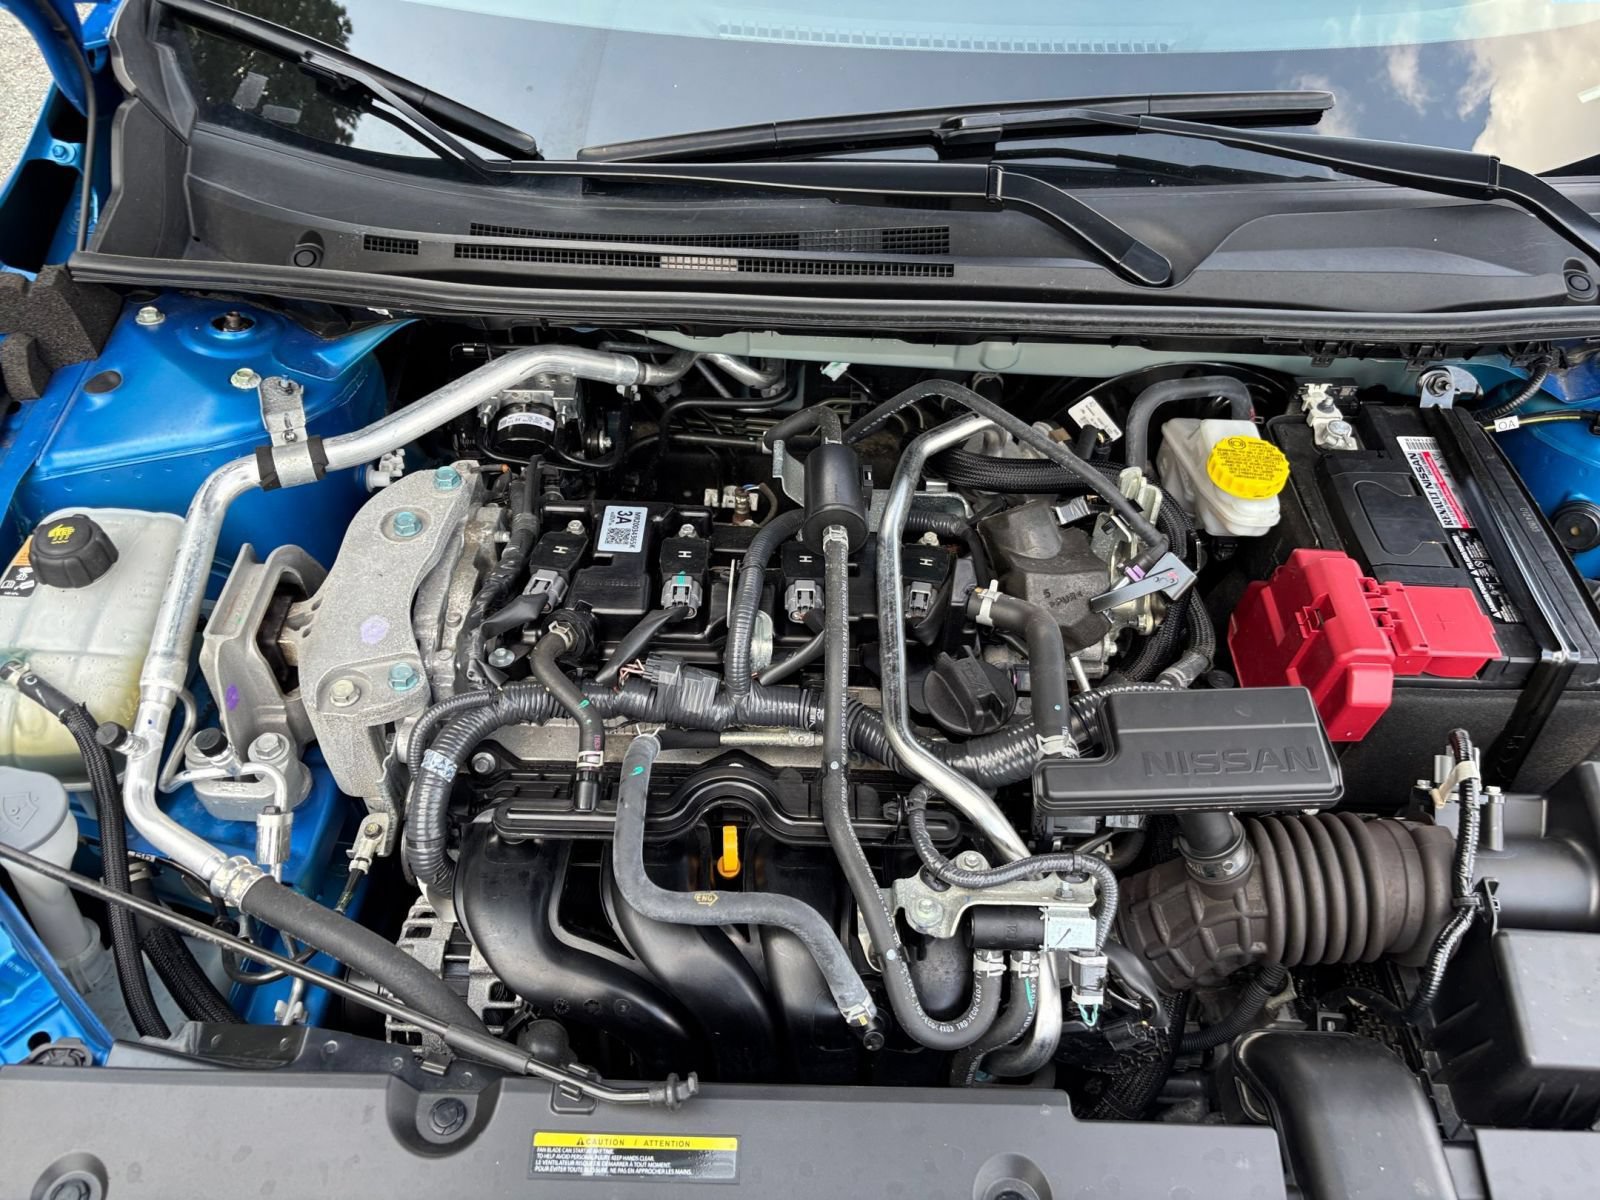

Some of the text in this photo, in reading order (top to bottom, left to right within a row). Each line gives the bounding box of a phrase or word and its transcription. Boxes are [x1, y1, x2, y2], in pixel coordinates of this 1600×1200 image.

[1407, 452, 1434, 490] NISSAN
[1428, 490, 1455, 526] RENAULT
[615, 510, 634, 525] 3A
[552, 545, 569, 554] H
[678, 550, 692, 558] H
[799, 555, 813, 563] H
[919, 558, 934, 566] H
[1143, 745, 1322, 777] NISSAN
[585, 1138, 625, 1146] CAUTION
[643, 1139, 691, 1147] ATTENTION
